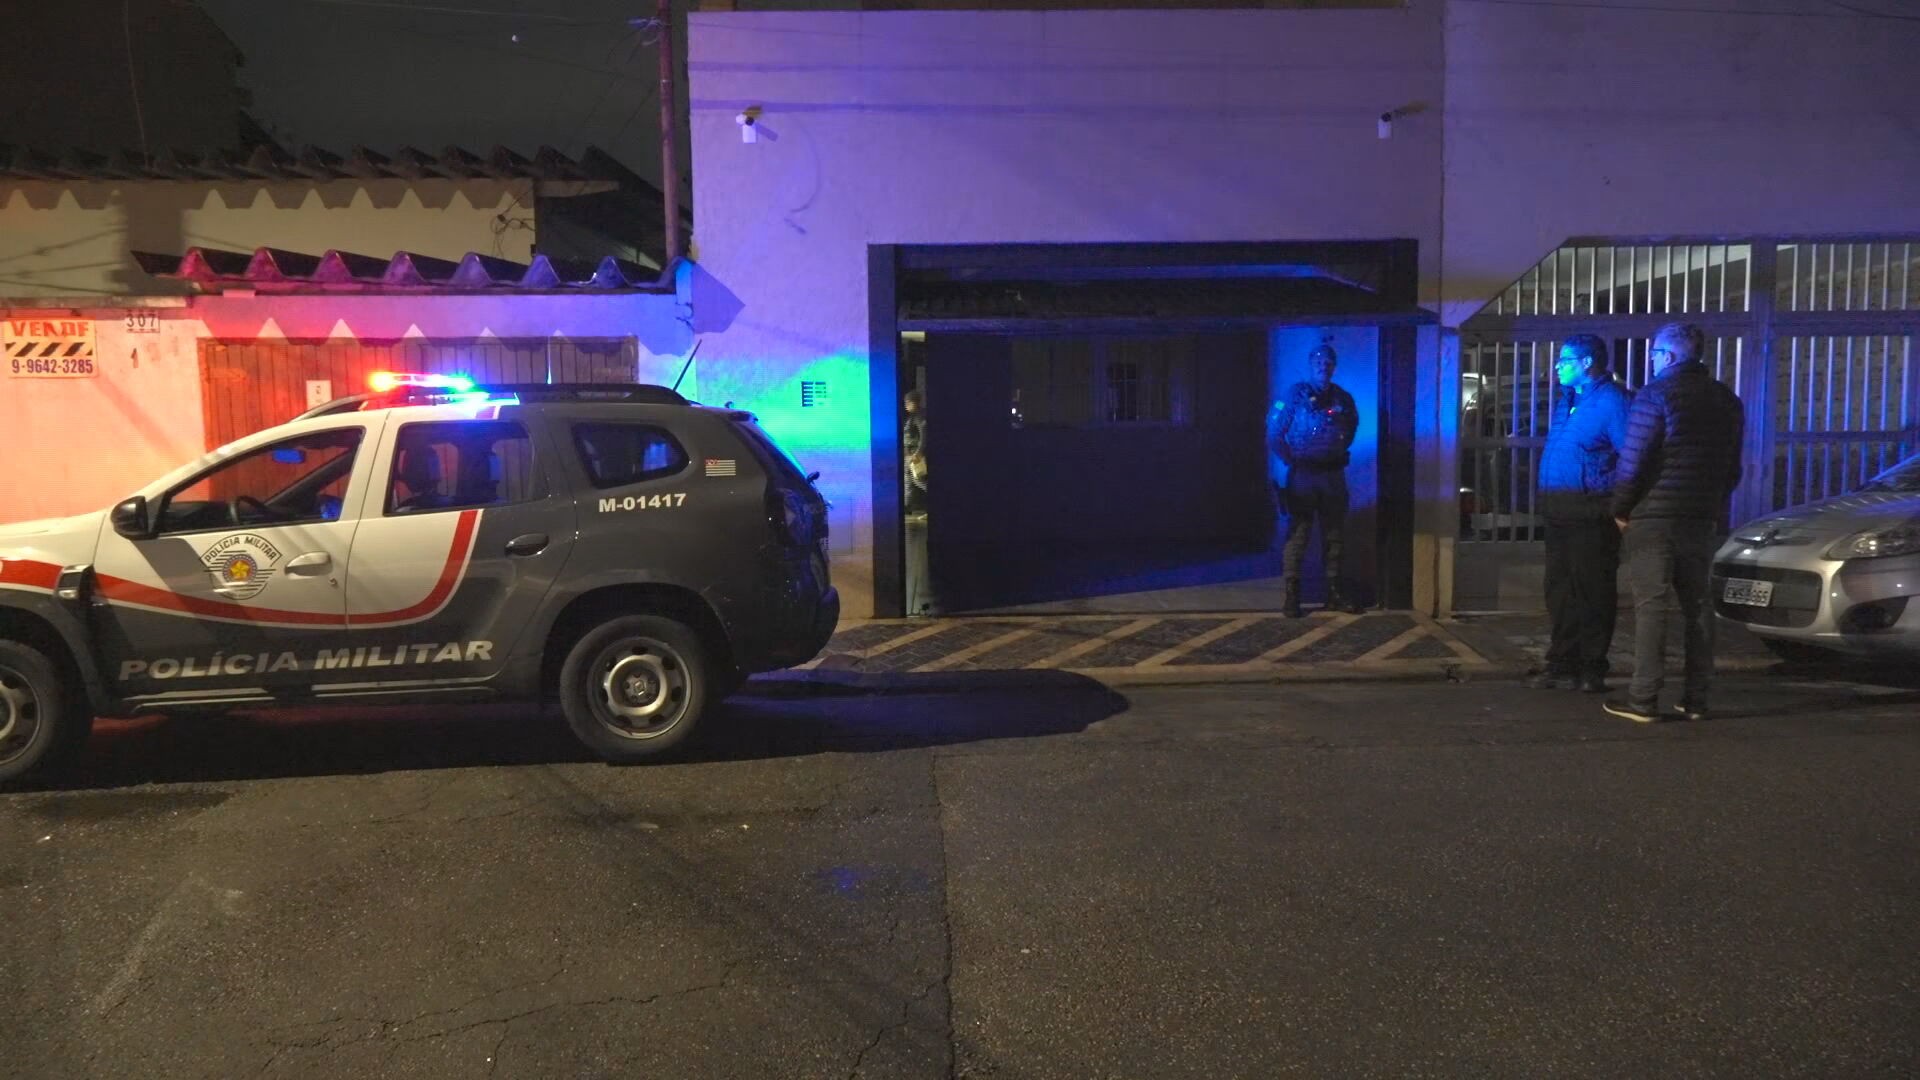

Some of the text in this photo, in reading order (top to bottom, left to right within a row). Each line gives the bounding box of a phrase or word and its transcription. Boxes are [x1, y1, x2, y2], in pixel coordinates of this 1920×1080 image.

[126, 313, 157, 328] 307
[11, 359, 94, 374] 9-9642-3285
[599, 493, 687, 513] M-01417
[244, 536, 277, 560] MILITAR
[118, 640, 494, 681] POLÍCIA MILITAR
